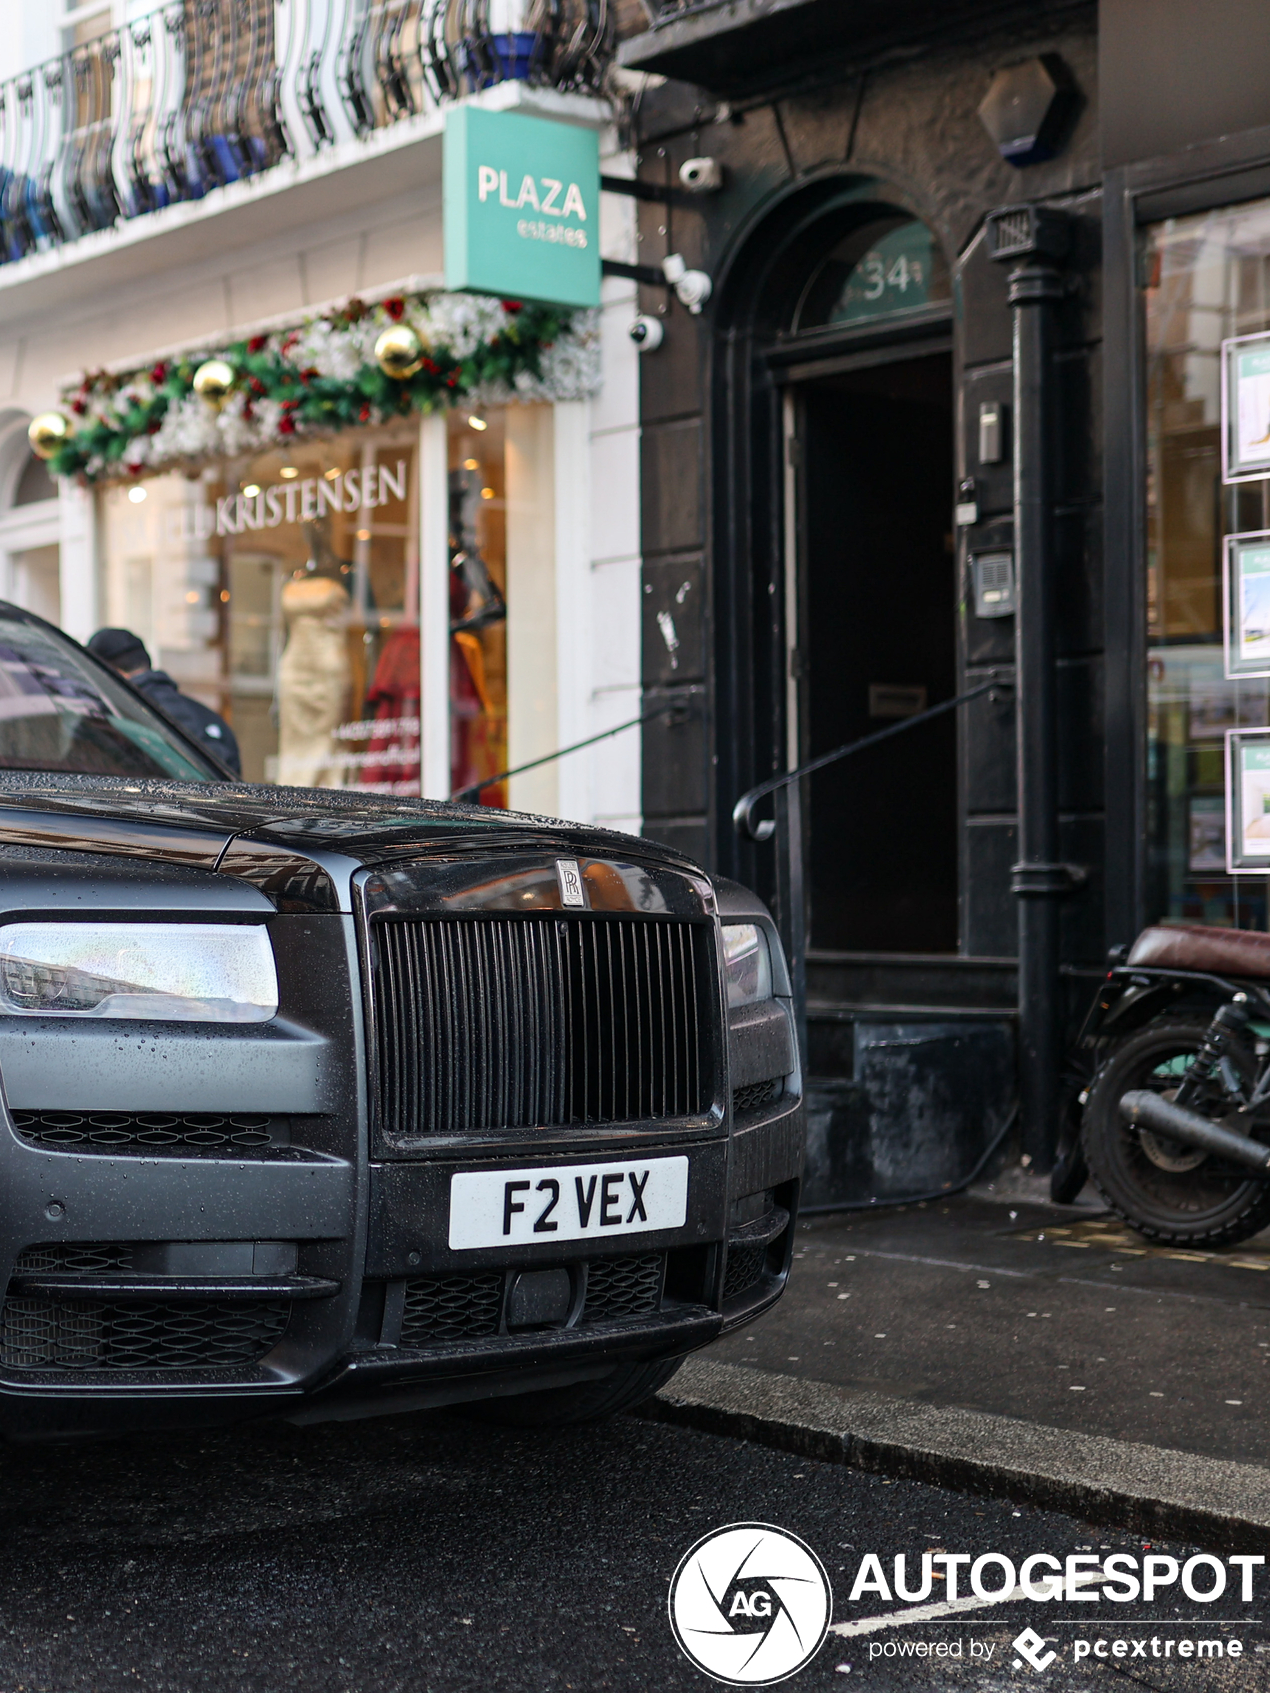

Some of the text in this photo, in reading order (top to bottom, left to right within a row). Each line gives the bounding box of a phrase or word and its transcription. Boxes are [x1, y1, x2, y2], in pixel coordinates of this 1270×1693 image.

[478, 165, 587, 221] PLAZA
[517, 218, 588, 248] estates
[864, 254, 910, 300] 34
[216, 460, 407, 537] KRISTENSEN
[502, 1170, 650, 1236] F2 VEX
